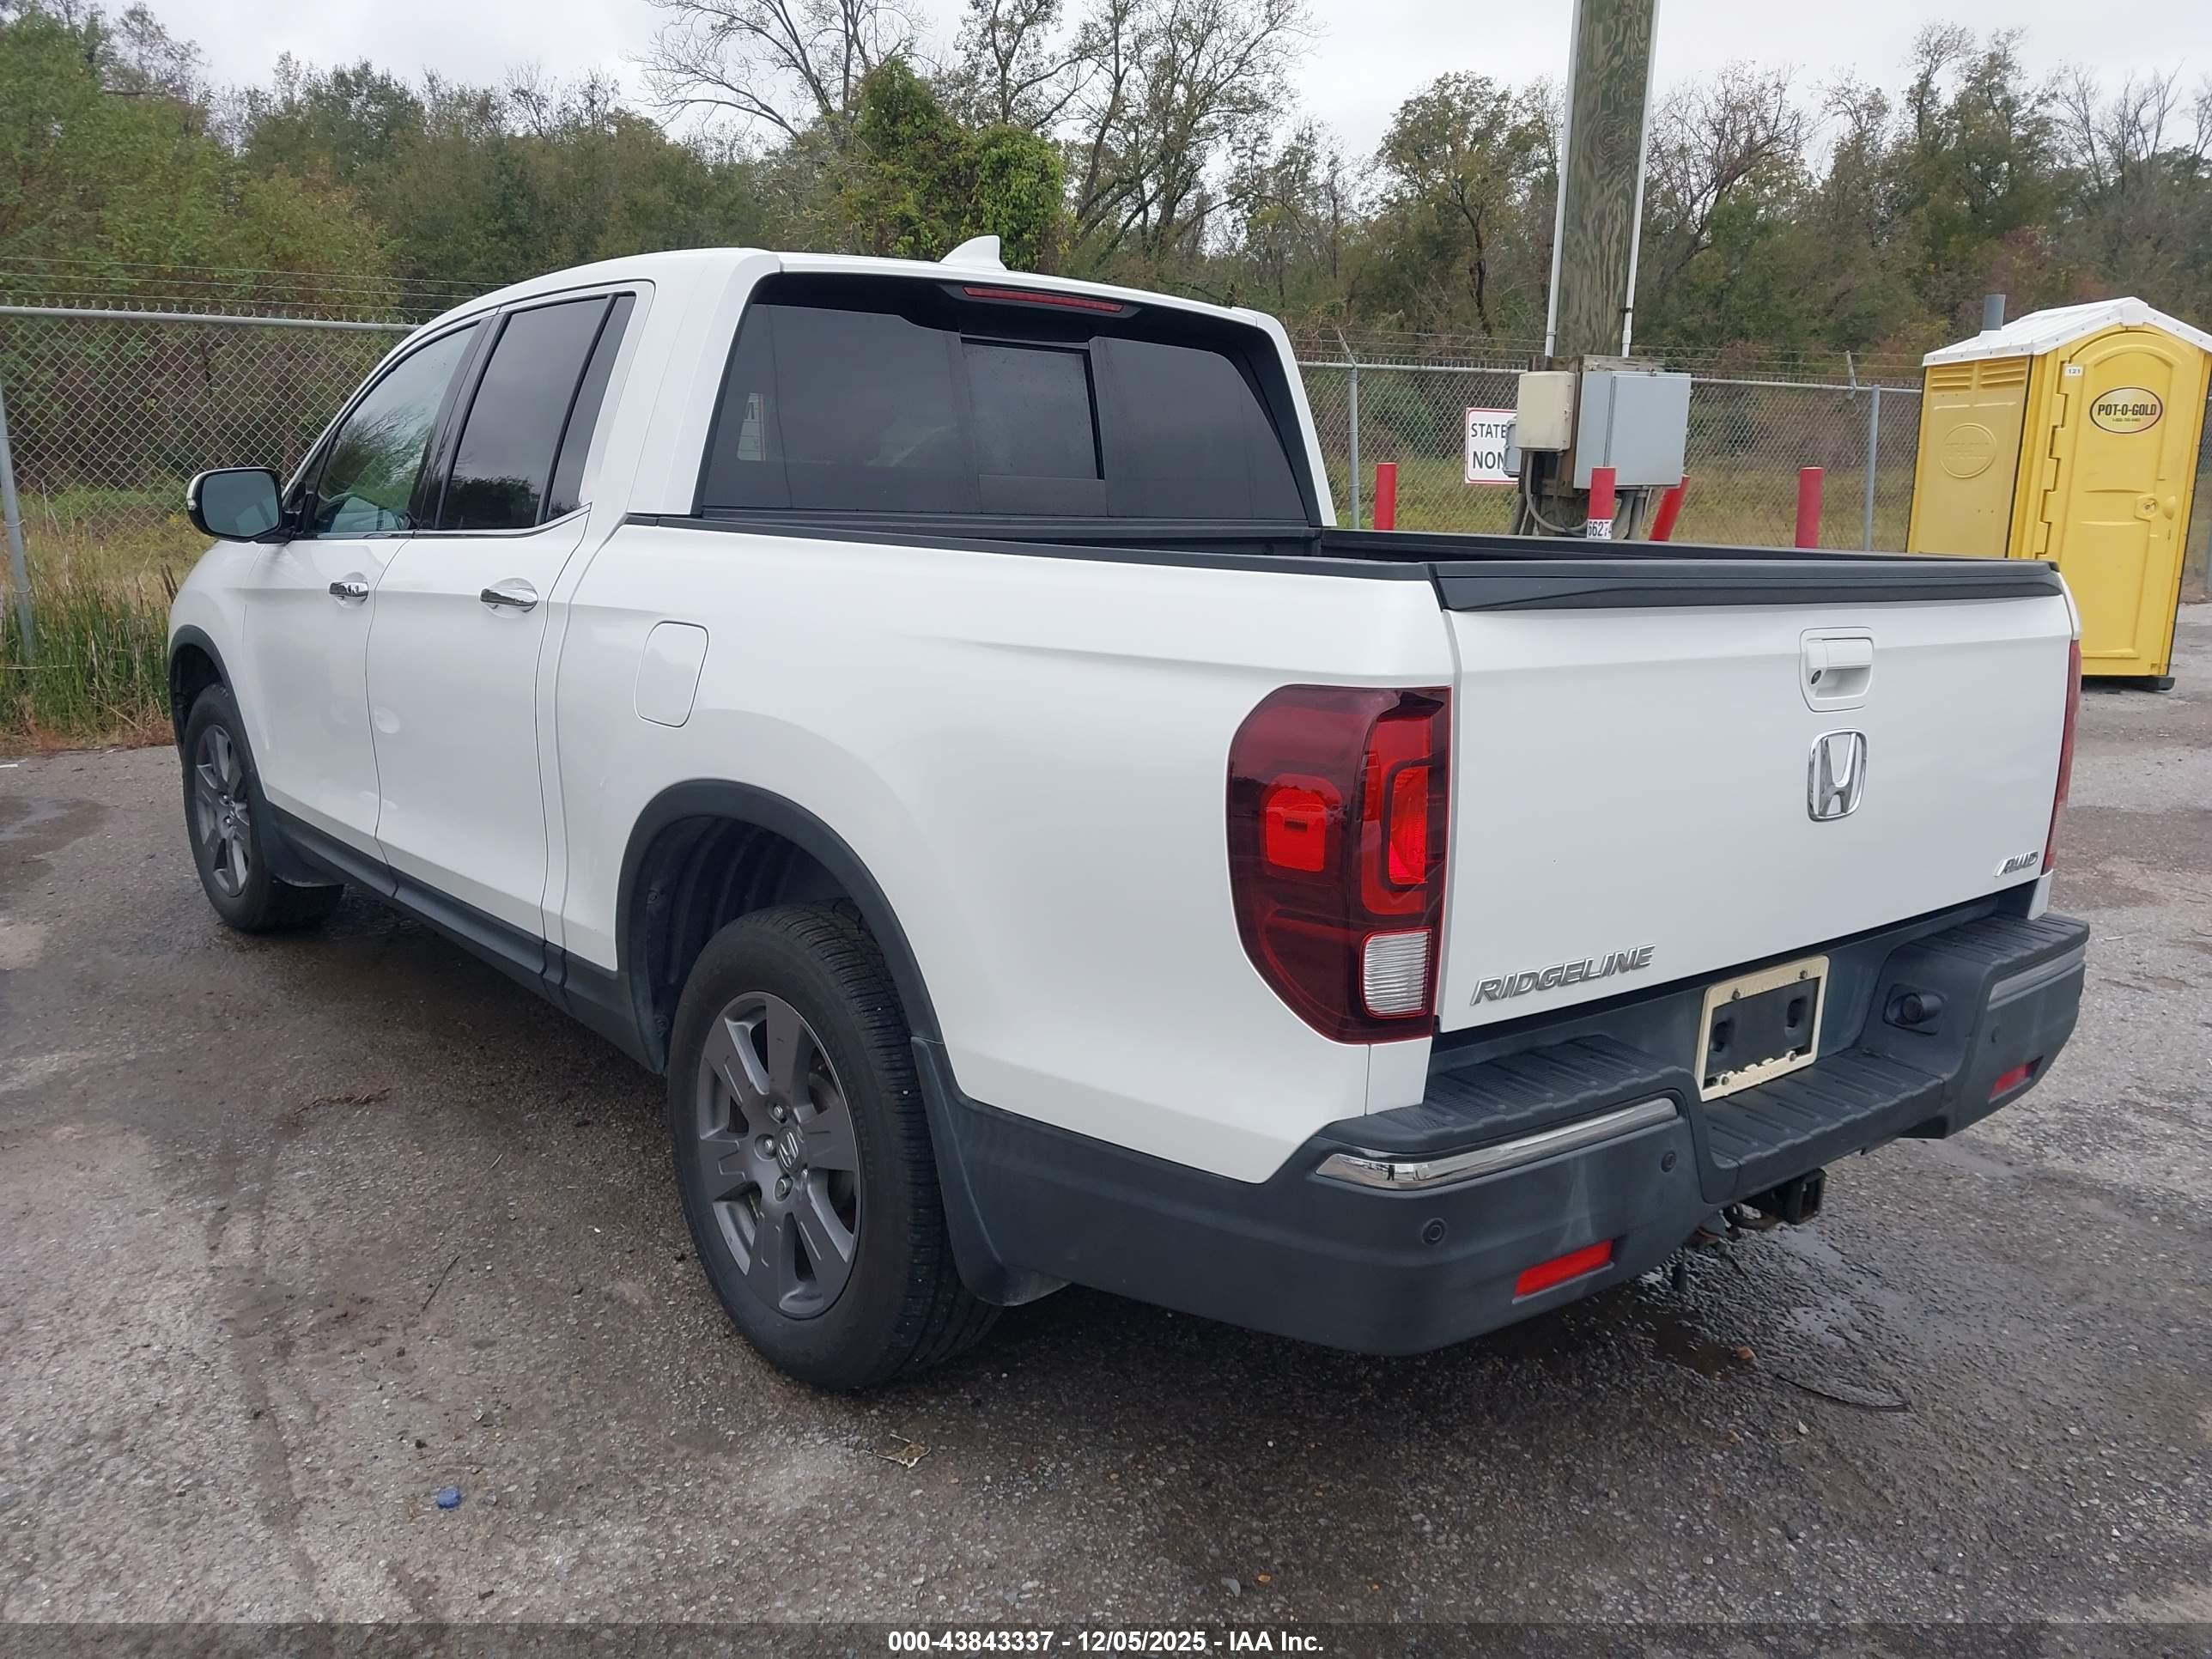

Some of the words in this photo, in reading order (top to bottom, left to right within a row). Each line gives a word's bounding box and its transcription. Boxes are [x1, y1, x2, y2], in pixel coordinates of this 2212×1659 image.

[2098, 404, 2156, 416] POT-O-GOLD
[1471, 422, 1507, 439] STATE
[1993, 850, 2039, 877] AWD
[1470, 944, 1656, 1006] RIDGELINE
